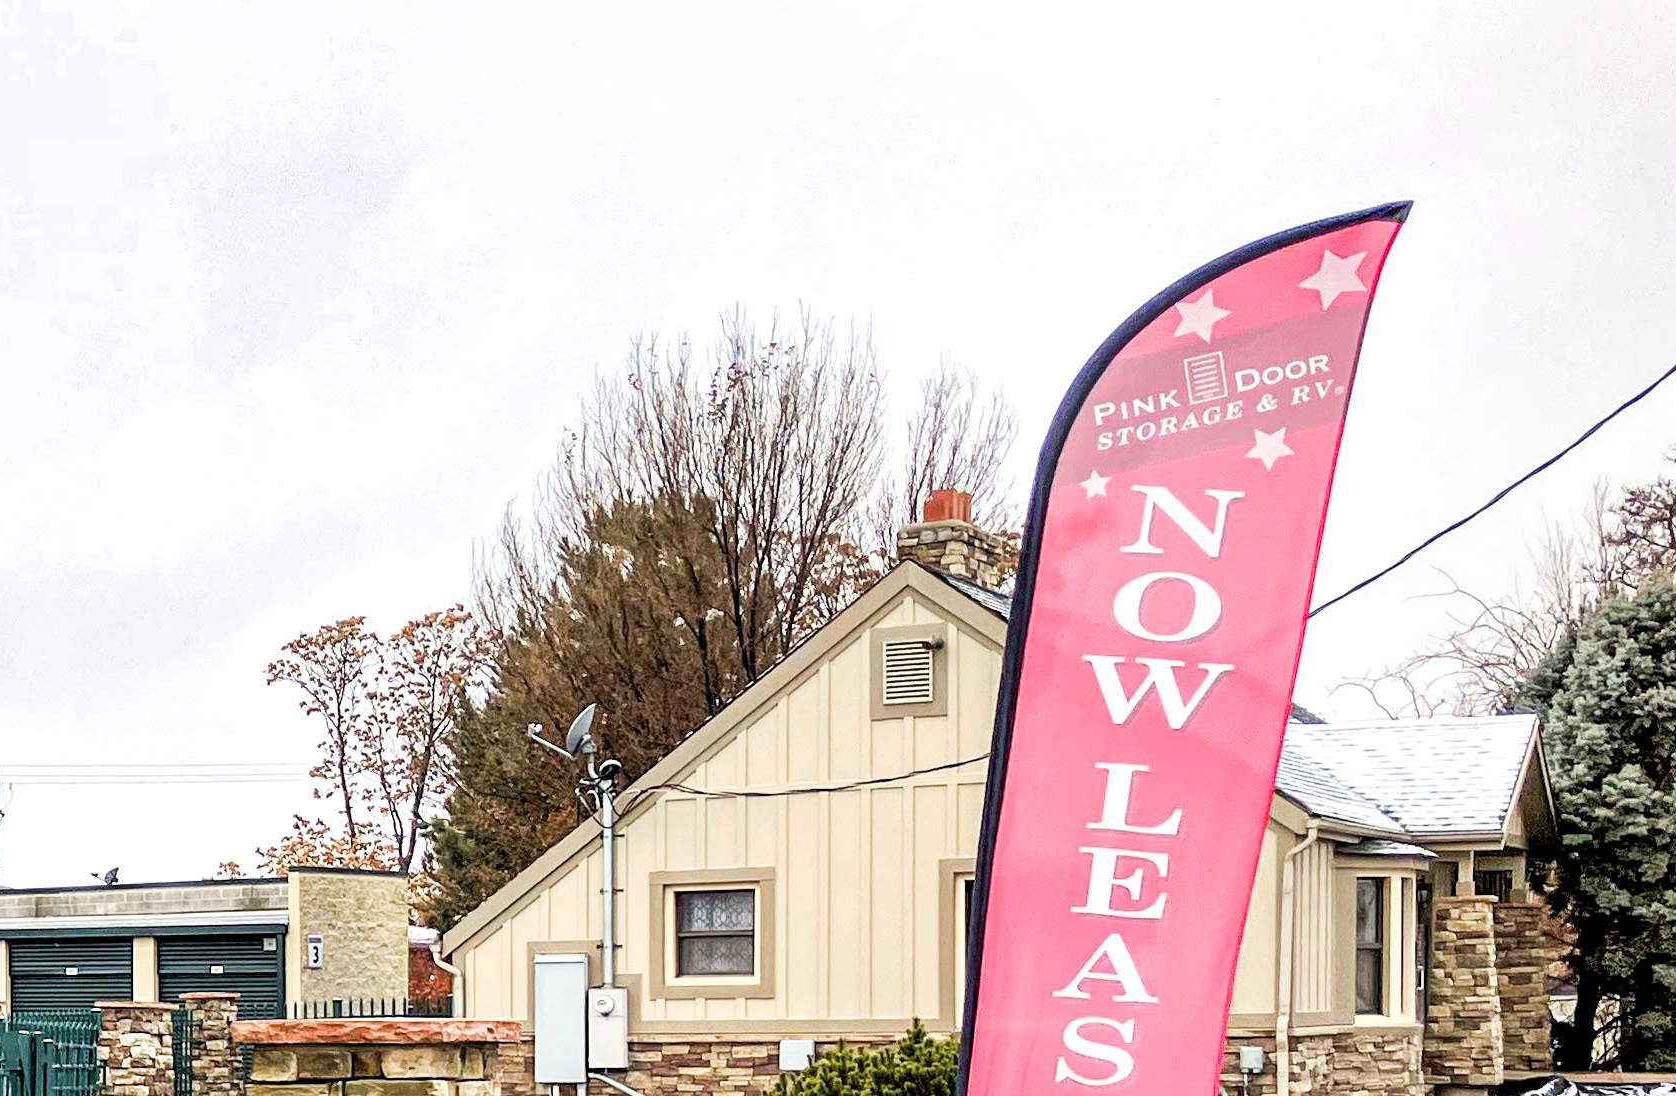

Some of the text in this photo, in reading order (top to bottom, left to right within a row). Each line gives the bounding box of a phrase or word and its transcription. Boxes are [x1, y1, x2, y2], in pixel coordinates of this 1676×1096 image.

[1093, 354, 1330, 426] PINK DOOR
[1097, 401, 1243, 450] STORAGE
[1256, 394, 1278, 413] &
[1082, 484, 1246, 731] NOW
[313, 946, 319, 963] 3
